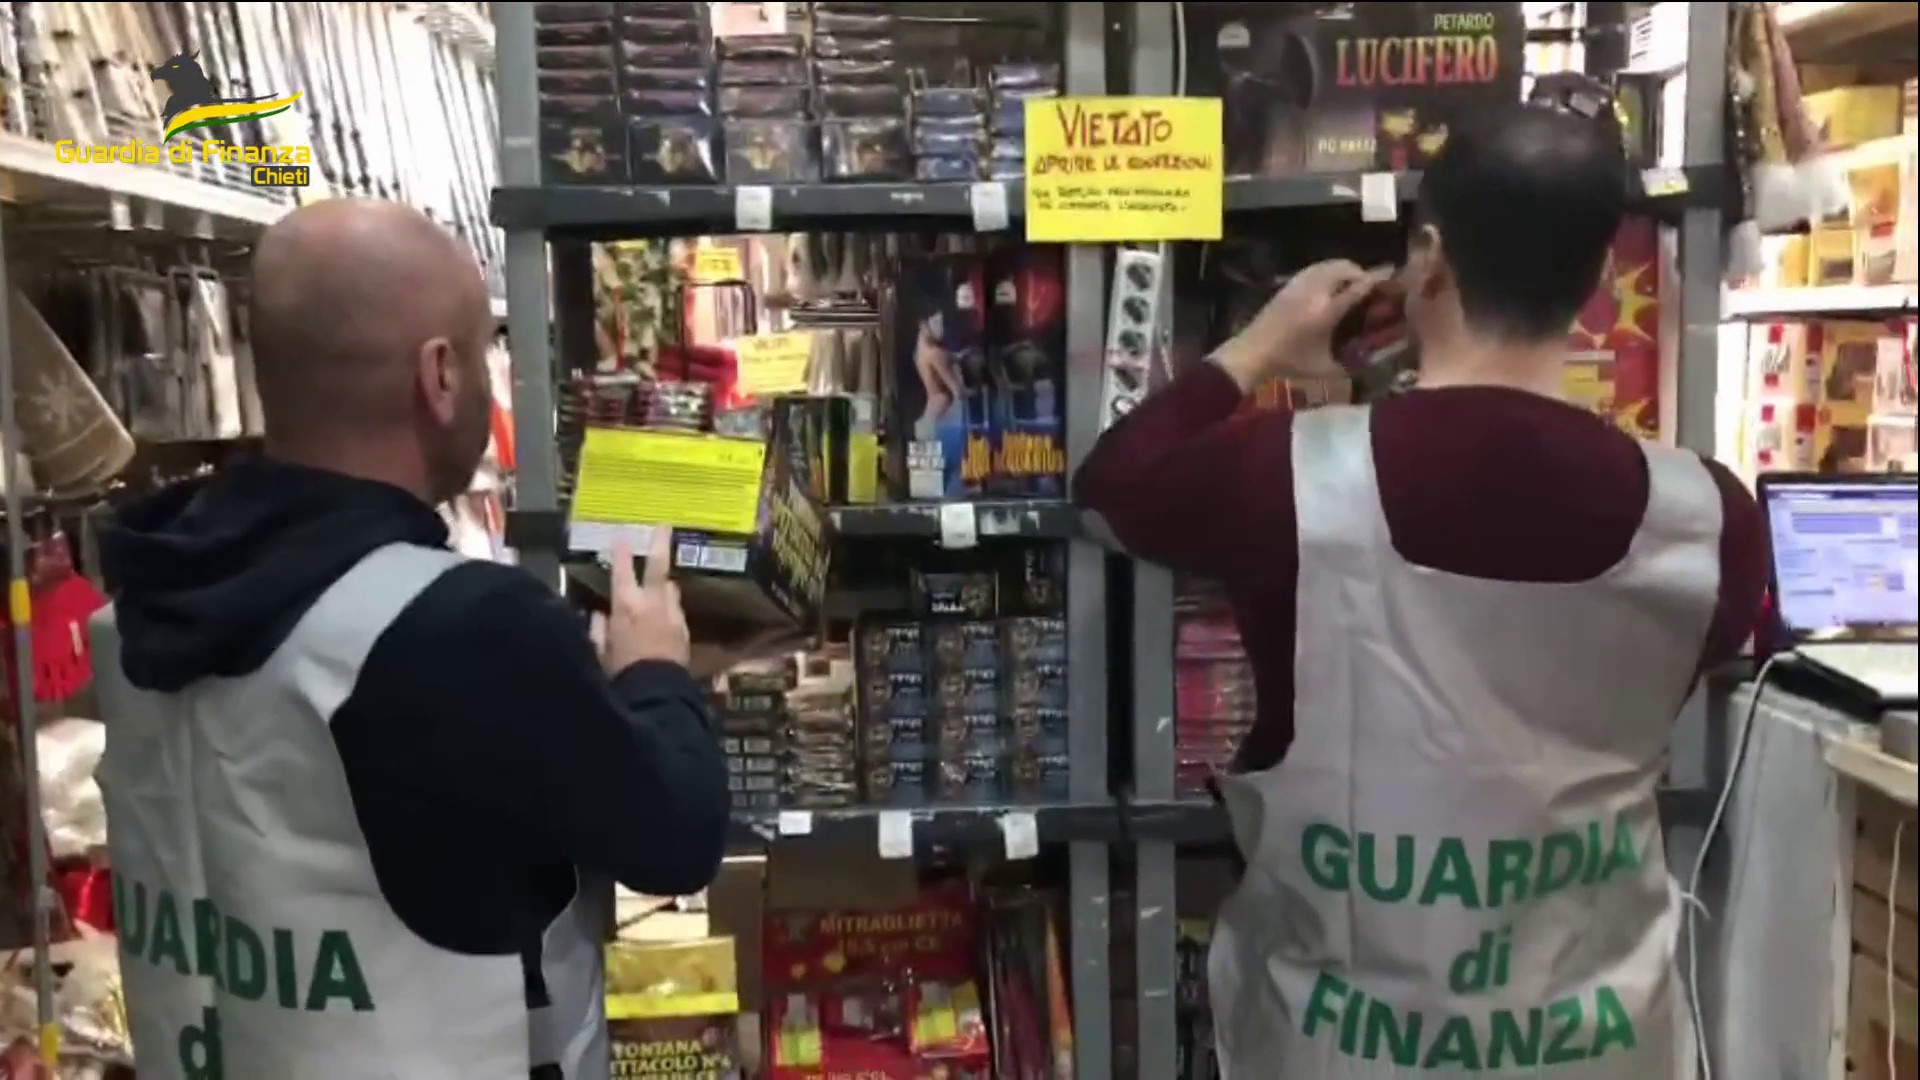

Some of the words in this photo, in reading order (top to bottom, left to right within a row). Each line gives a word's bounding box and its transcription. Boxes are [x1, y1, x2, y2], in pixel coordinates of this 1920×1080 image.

[1434, 13, 1495, 30] PETARDO
[1336, 35, 1498, 86] LUCIFERO
[1056, 103, 1173, 148] VIETATO
[1033, 154, 1096, 175] APRIRE
[1300, 816, 1640, 908] GUARDIA
[116, 872, 375, 1013] UARDIA
[820, 912, 962, 933] MITRAGLIETTA
[1449, 922, 1512, 995] di
[1302, 972, 1637, 1070] FINANZA
